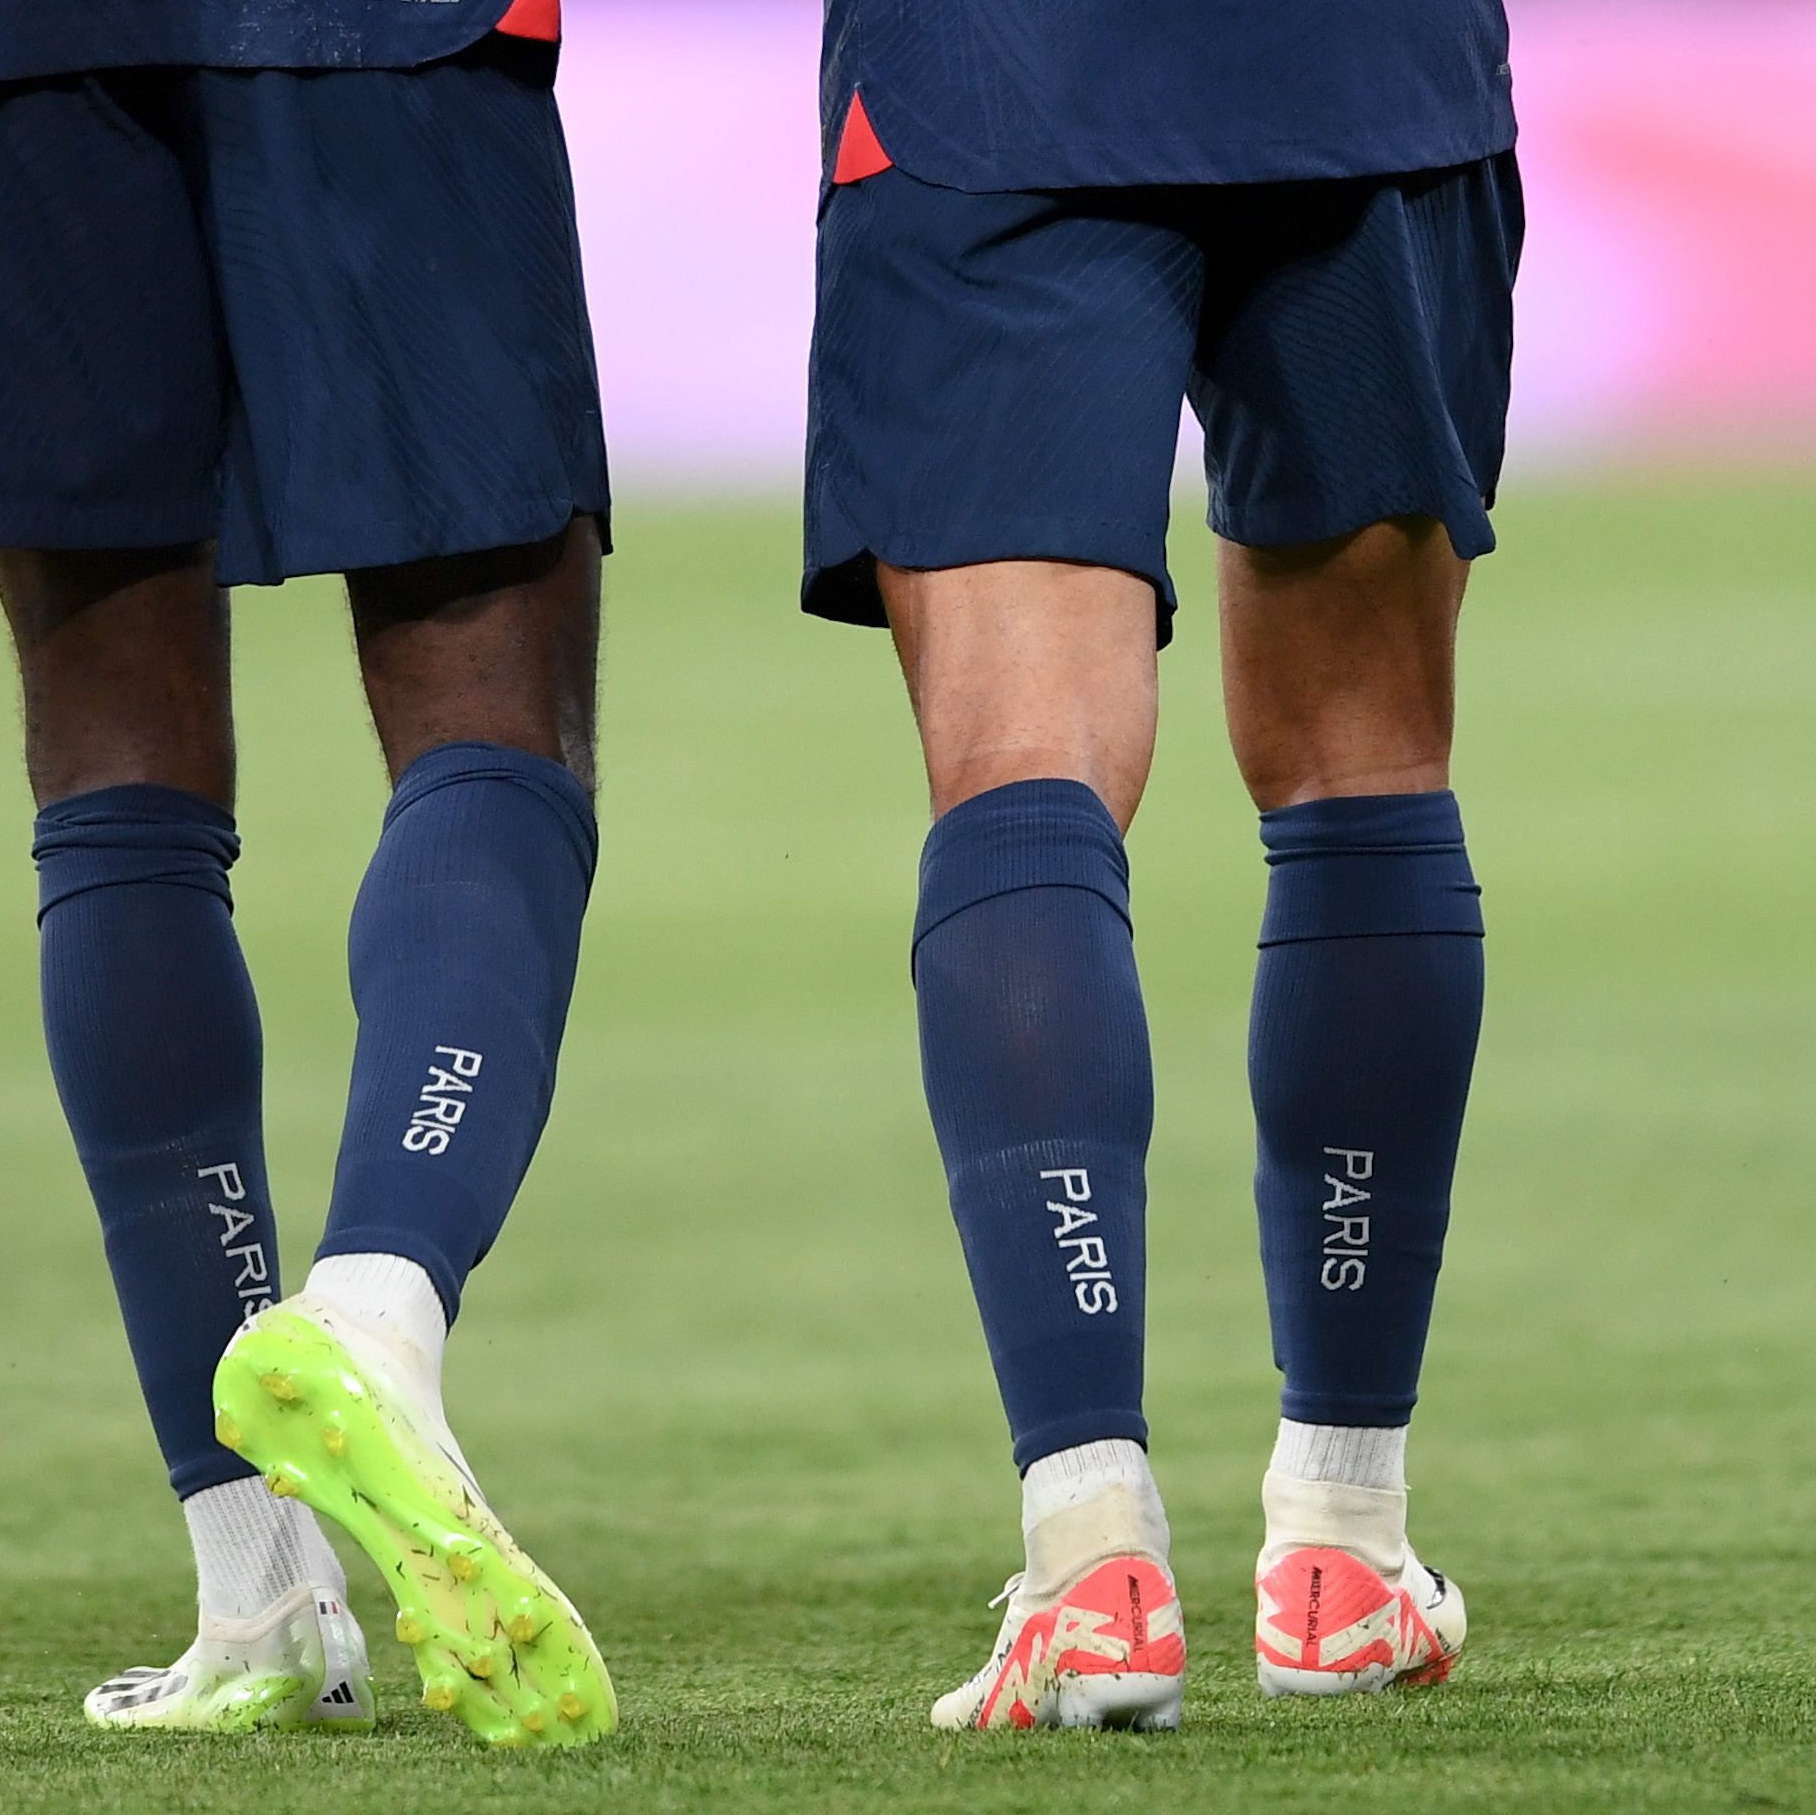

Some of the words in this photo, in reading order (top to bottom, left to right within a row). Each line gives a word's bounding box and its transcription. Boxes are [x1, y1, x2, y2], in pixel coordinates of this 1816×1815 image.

[402, 1045, 483, 1156] PARIS
[1040, 1167, 1118, 1315] PARIS
[1320, 1146, 1375, 1292] PARIS
[1127, 1574, 1144, 1653] MERCURIAL
[1306, 1566, 1322, 1647] MERCURIAL
